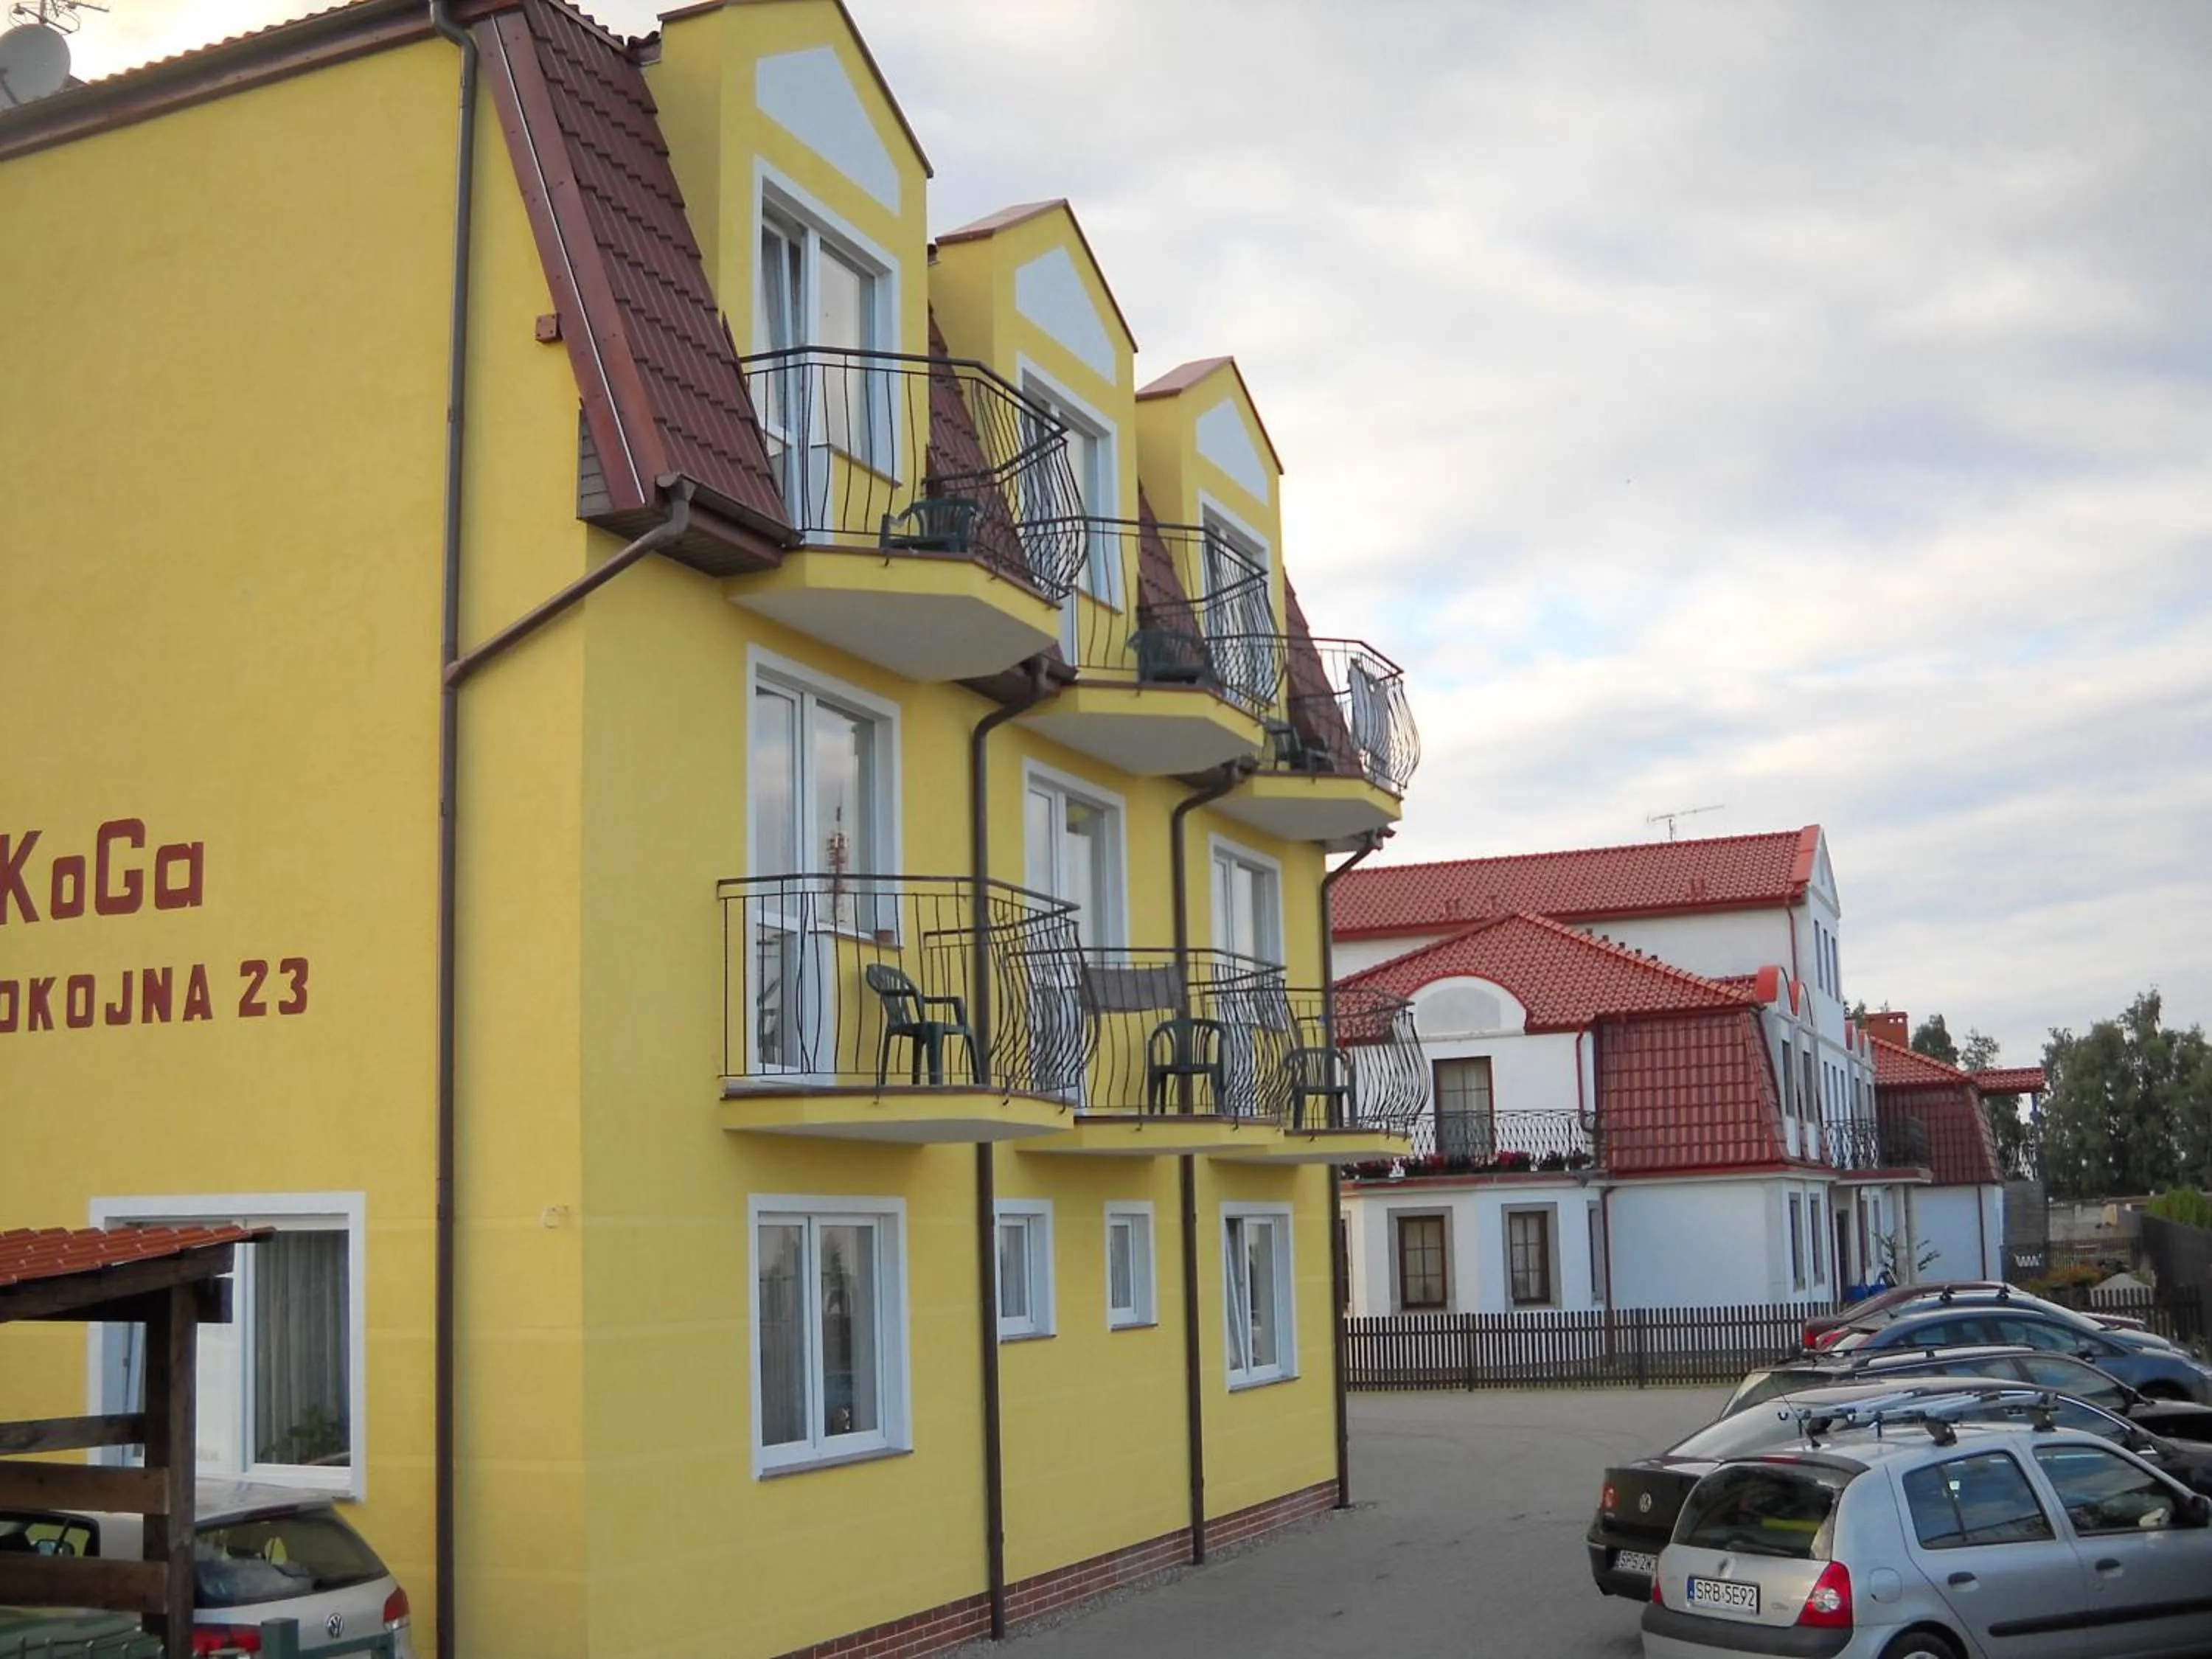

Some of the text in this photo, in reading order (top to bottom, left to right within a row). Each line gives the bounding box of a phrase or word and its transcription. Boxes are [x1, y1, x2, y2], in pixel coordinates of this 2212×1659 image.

[0, 818, 204, 926] KoGa
[238, 957, 309, 1018] 23
[1696, 1581, 1720, 1602] SRB
[1725, 1585, 1755, 1607] 5E92
